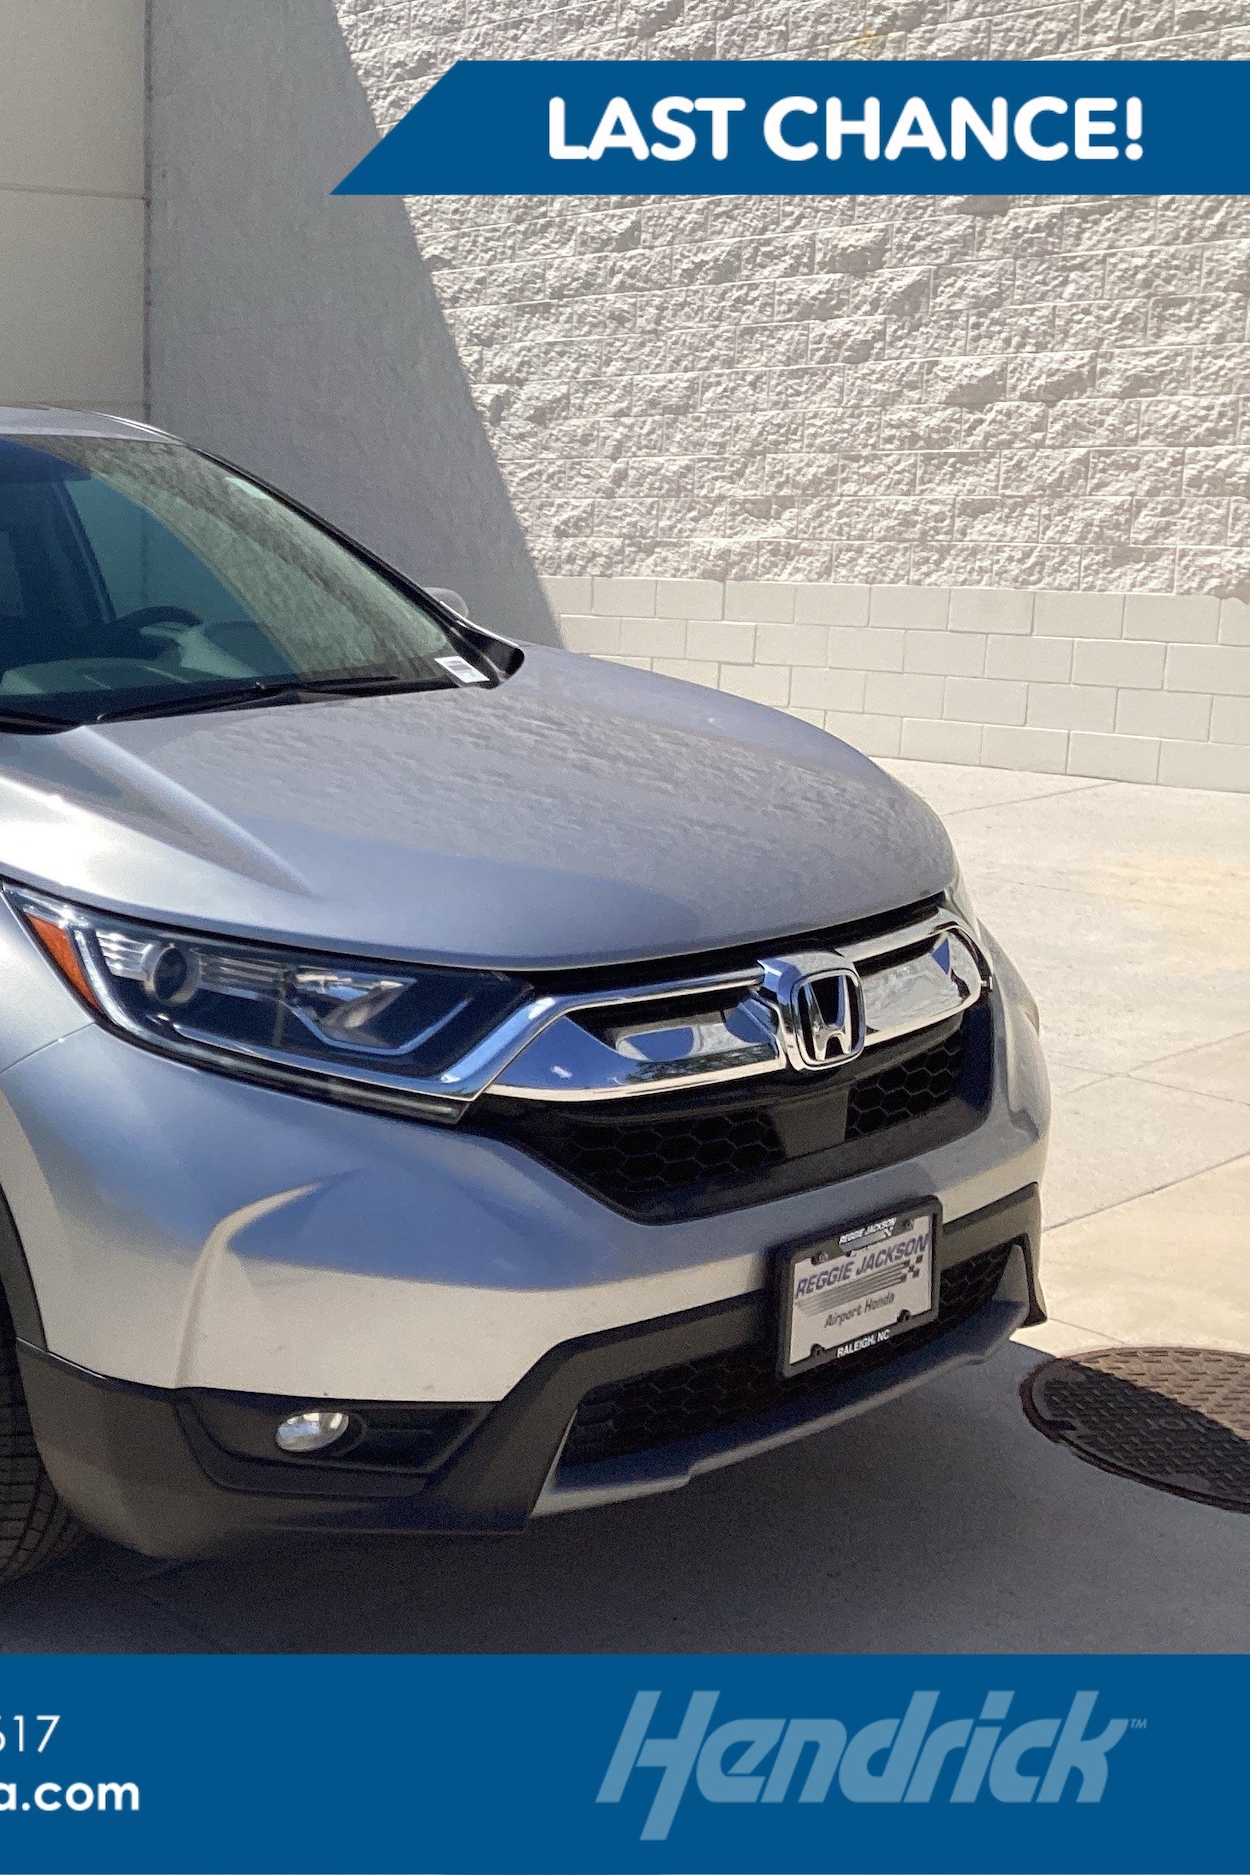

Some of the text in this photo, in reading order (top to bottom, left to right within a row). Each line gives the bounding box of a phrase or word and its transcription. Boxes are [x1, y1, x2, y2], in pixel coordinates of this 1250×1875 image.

[839, 1217, 897, 1245] REGGIE JACKSON
[794, 1232, 931, 1300] REGGIE JACKSON
[824, 1291, 895, 1327] Airport Honda
[877, 1328, 891, 1343] NC
